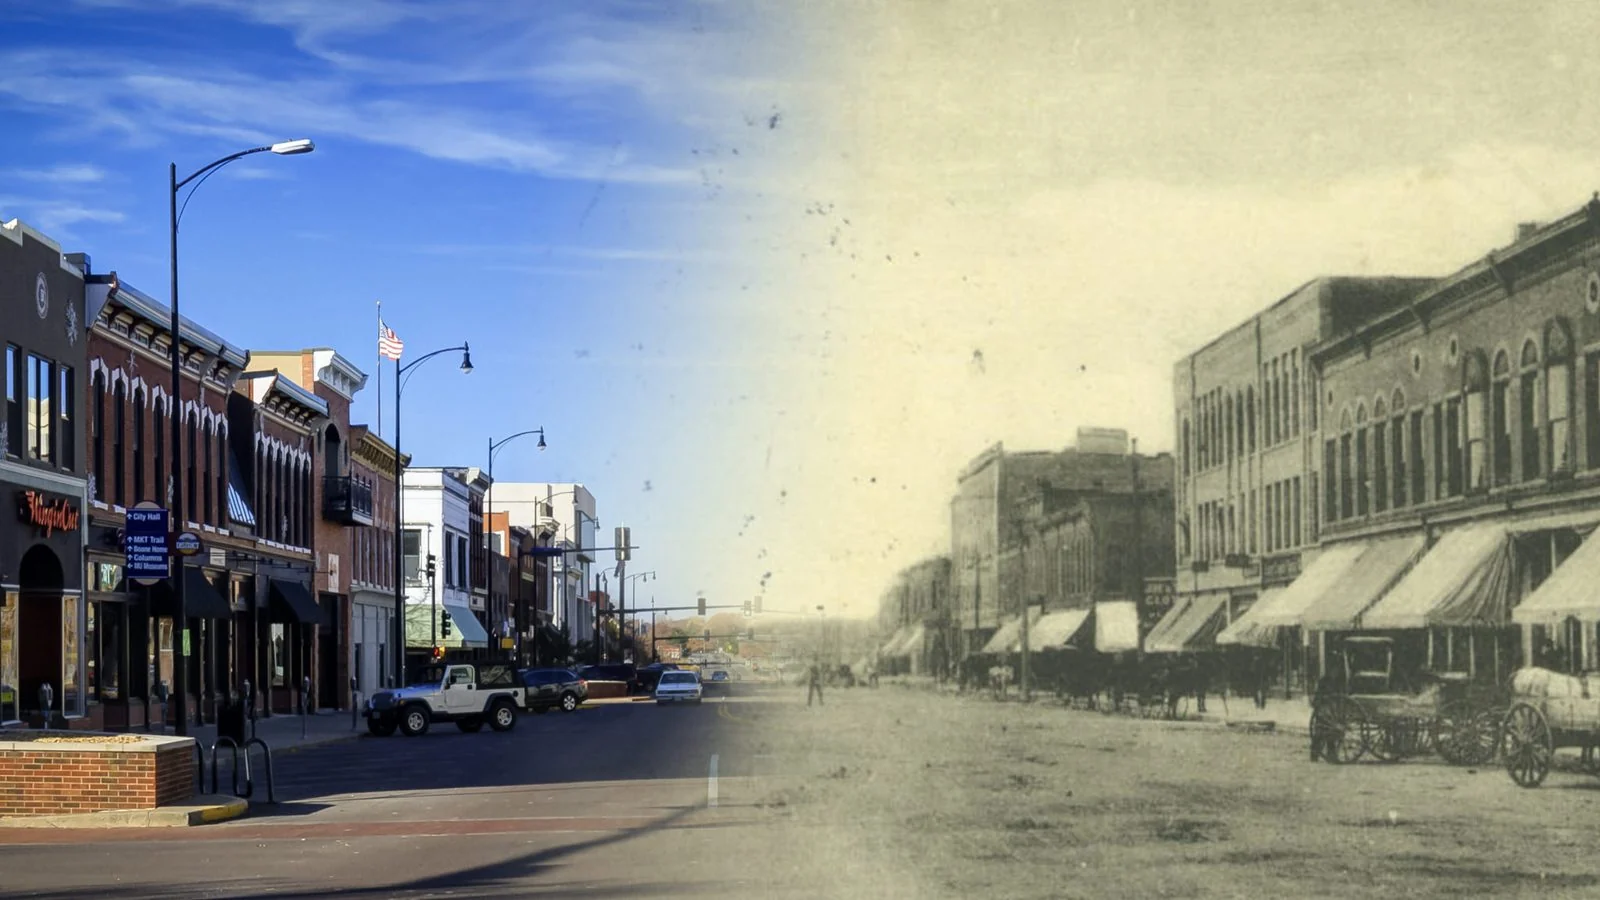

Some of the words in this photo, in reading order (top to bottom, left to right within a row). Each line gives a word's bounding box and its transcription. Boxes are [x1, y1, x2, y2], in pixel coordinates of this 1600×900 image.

[133, 512, 147, 522] City
[147, 512, 161, 521] Hall
[133, 535, 148, 543] MKT
[150, 535, 165, 544] Trail
[133, 553, 163, 562] Columns
